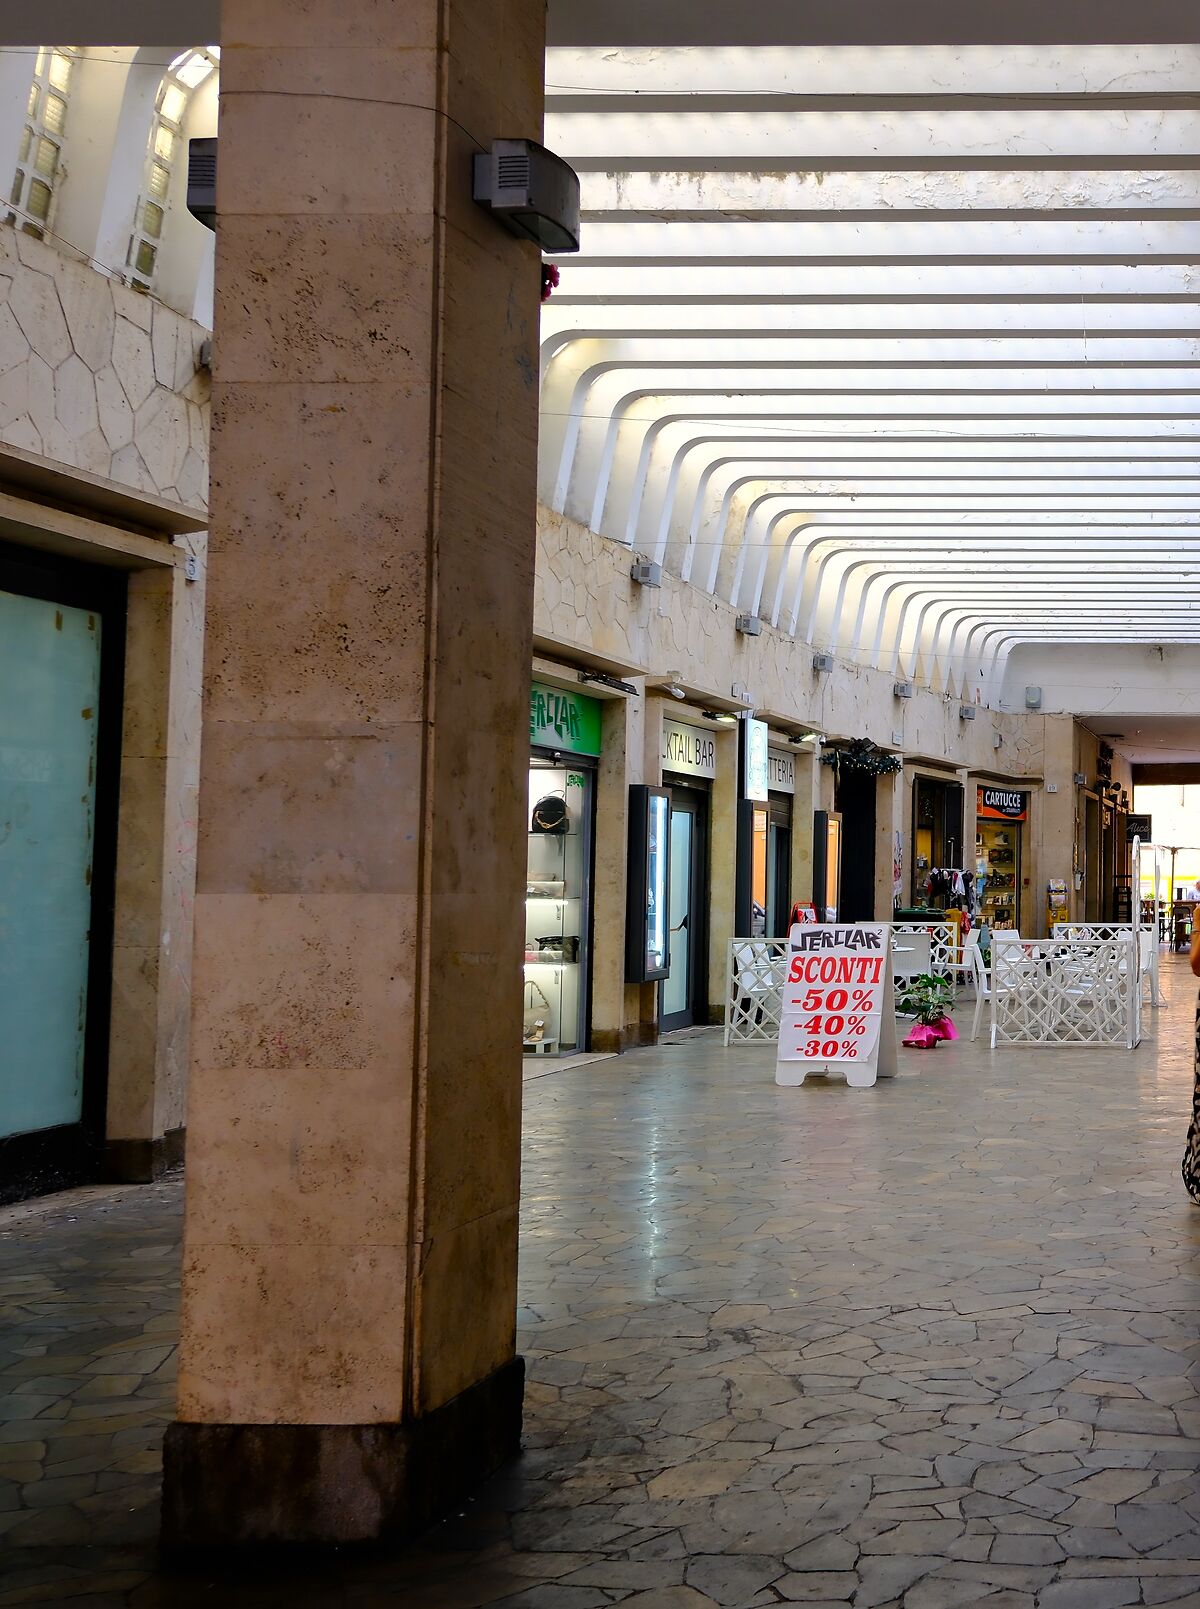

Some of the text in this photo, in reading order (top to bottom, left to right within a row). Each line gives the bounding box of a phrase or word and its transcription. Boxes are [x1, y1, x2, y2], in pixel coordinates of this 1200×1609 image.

[695, 737, 715, 769] BAR
[985, 790, 1021, 808] CARTUCCE
[788, 955, 884, 984] SCONTI
[791, 989, 874, 1012] -50%
[794, 1015, 867, 1036] -40%
[796, 1040, 858, 1058] -30%
